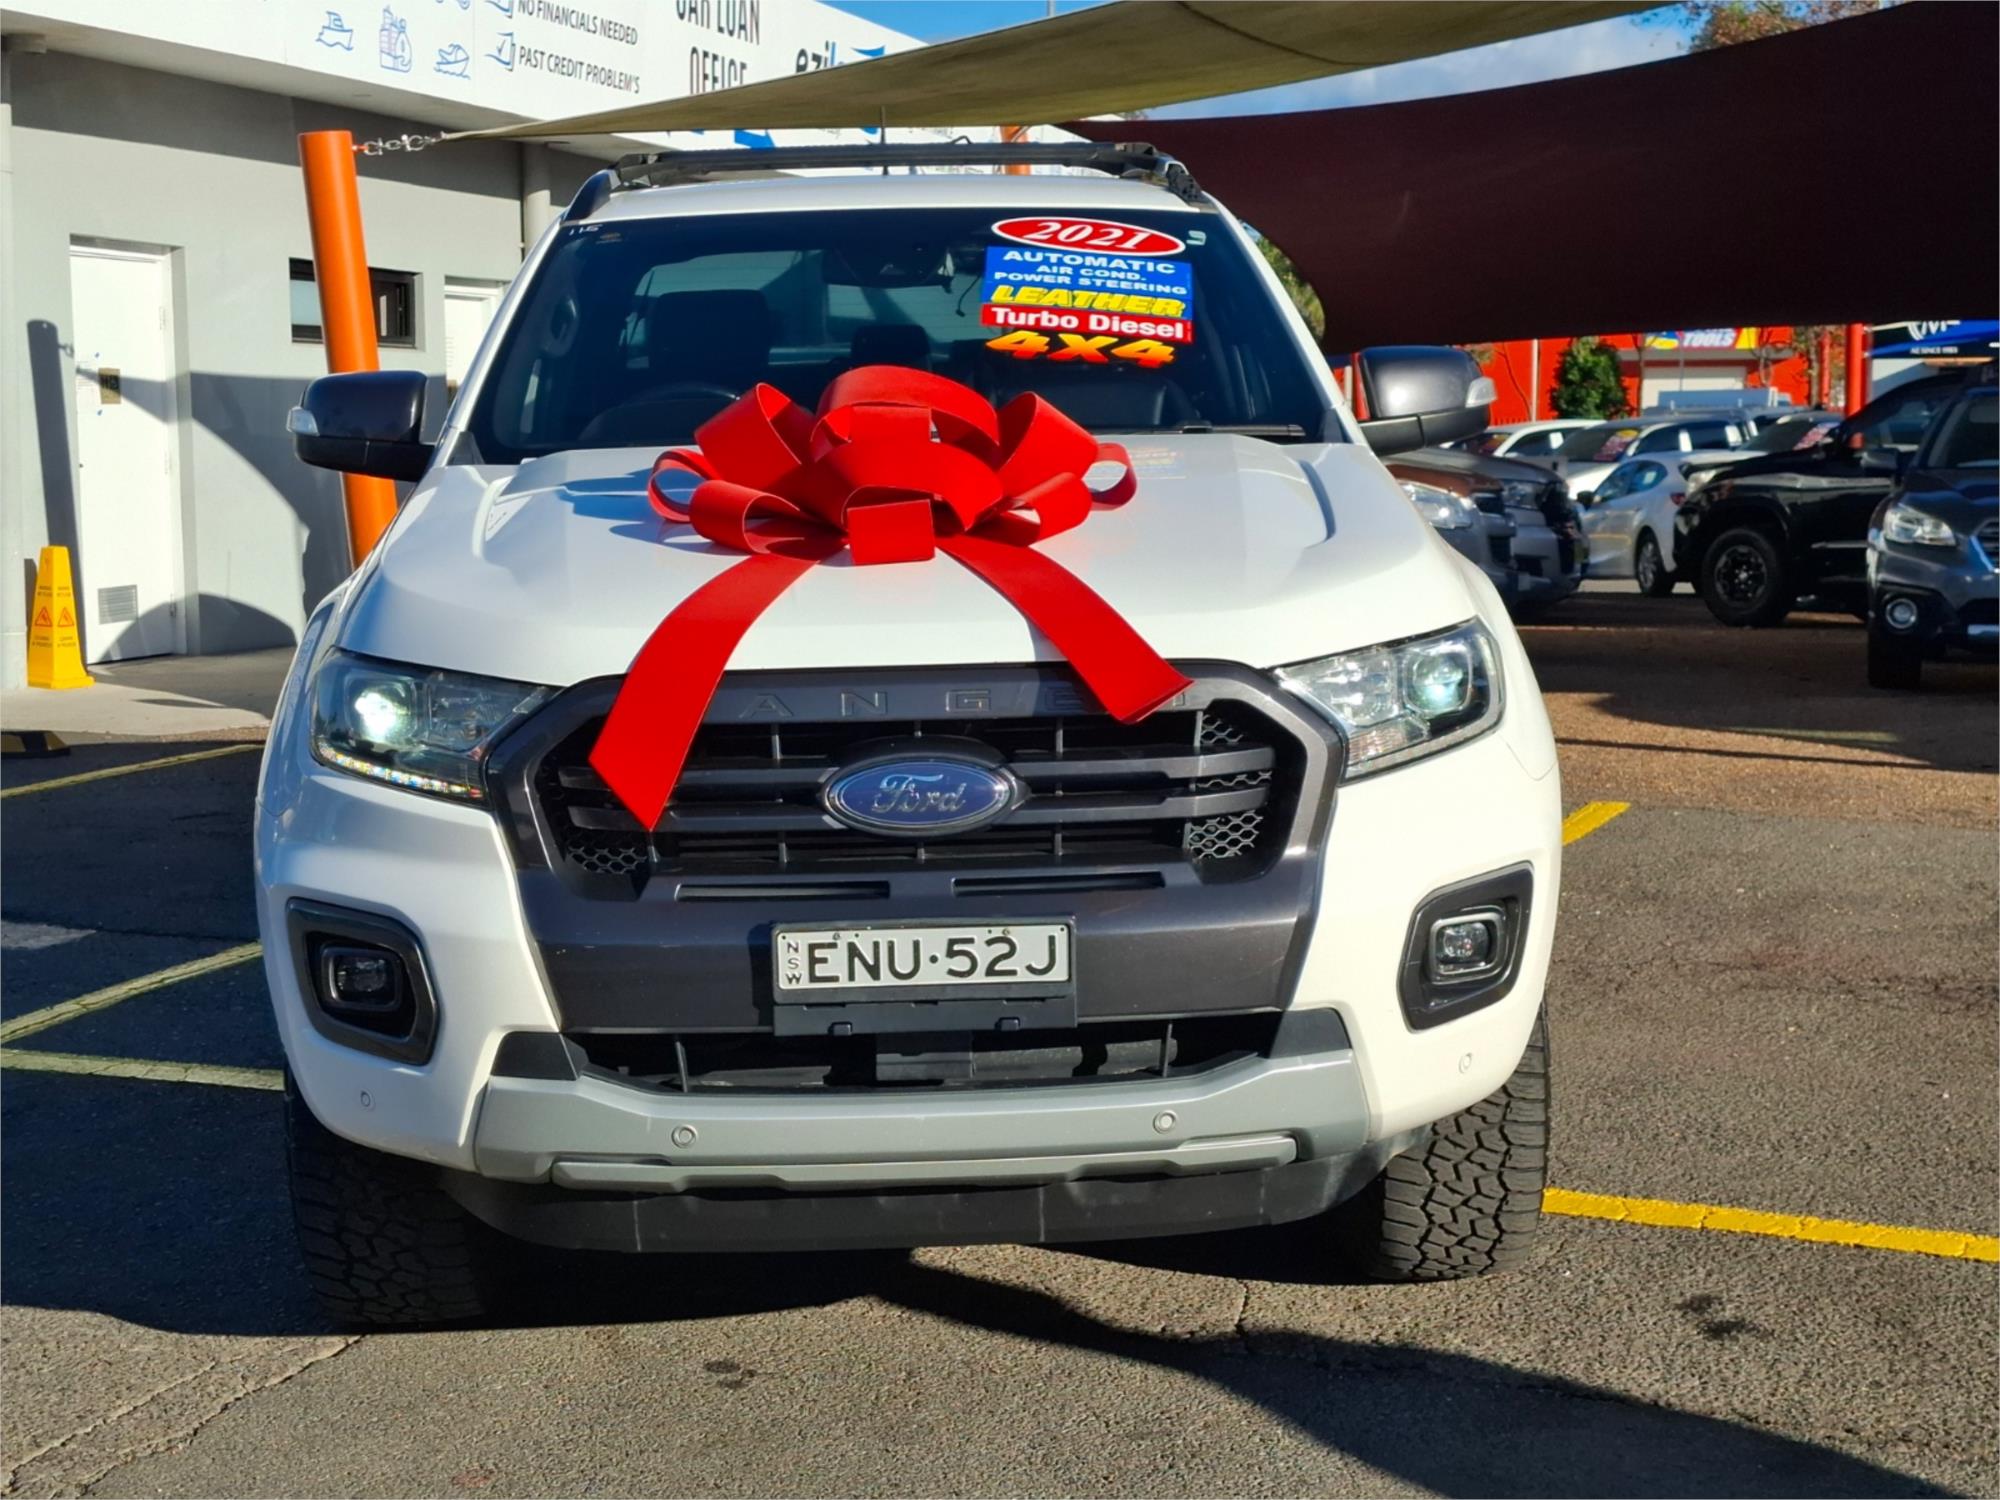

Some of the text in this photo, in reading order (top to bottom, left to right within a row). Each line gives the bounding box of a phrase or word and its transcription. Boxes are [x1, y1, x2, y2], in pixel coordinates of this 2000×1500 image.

[518, 0, 638, 46] NO FINANCIALS NEEDED
[717, 0, 760, 46] LOAN
[519, 46, 640, 94] PAST CREDIT PROBLEM'S
[1023, 221, 1154, 250] 2021
[1003, 250, 1176, 274] AUTOMATIC
[1036, 264, 1147, 281] AIR COND.
[994, 271, 1187, 295] POWER STEERING
[991, 285, 1186, 317] LEATHER
[991, 307, 1184, 338] Turbo Diesel
[985, 329, 1175, 368] 4X4
[738, 688, 1188, 719] ANGE
[870, 773, 967, 815] Ford
